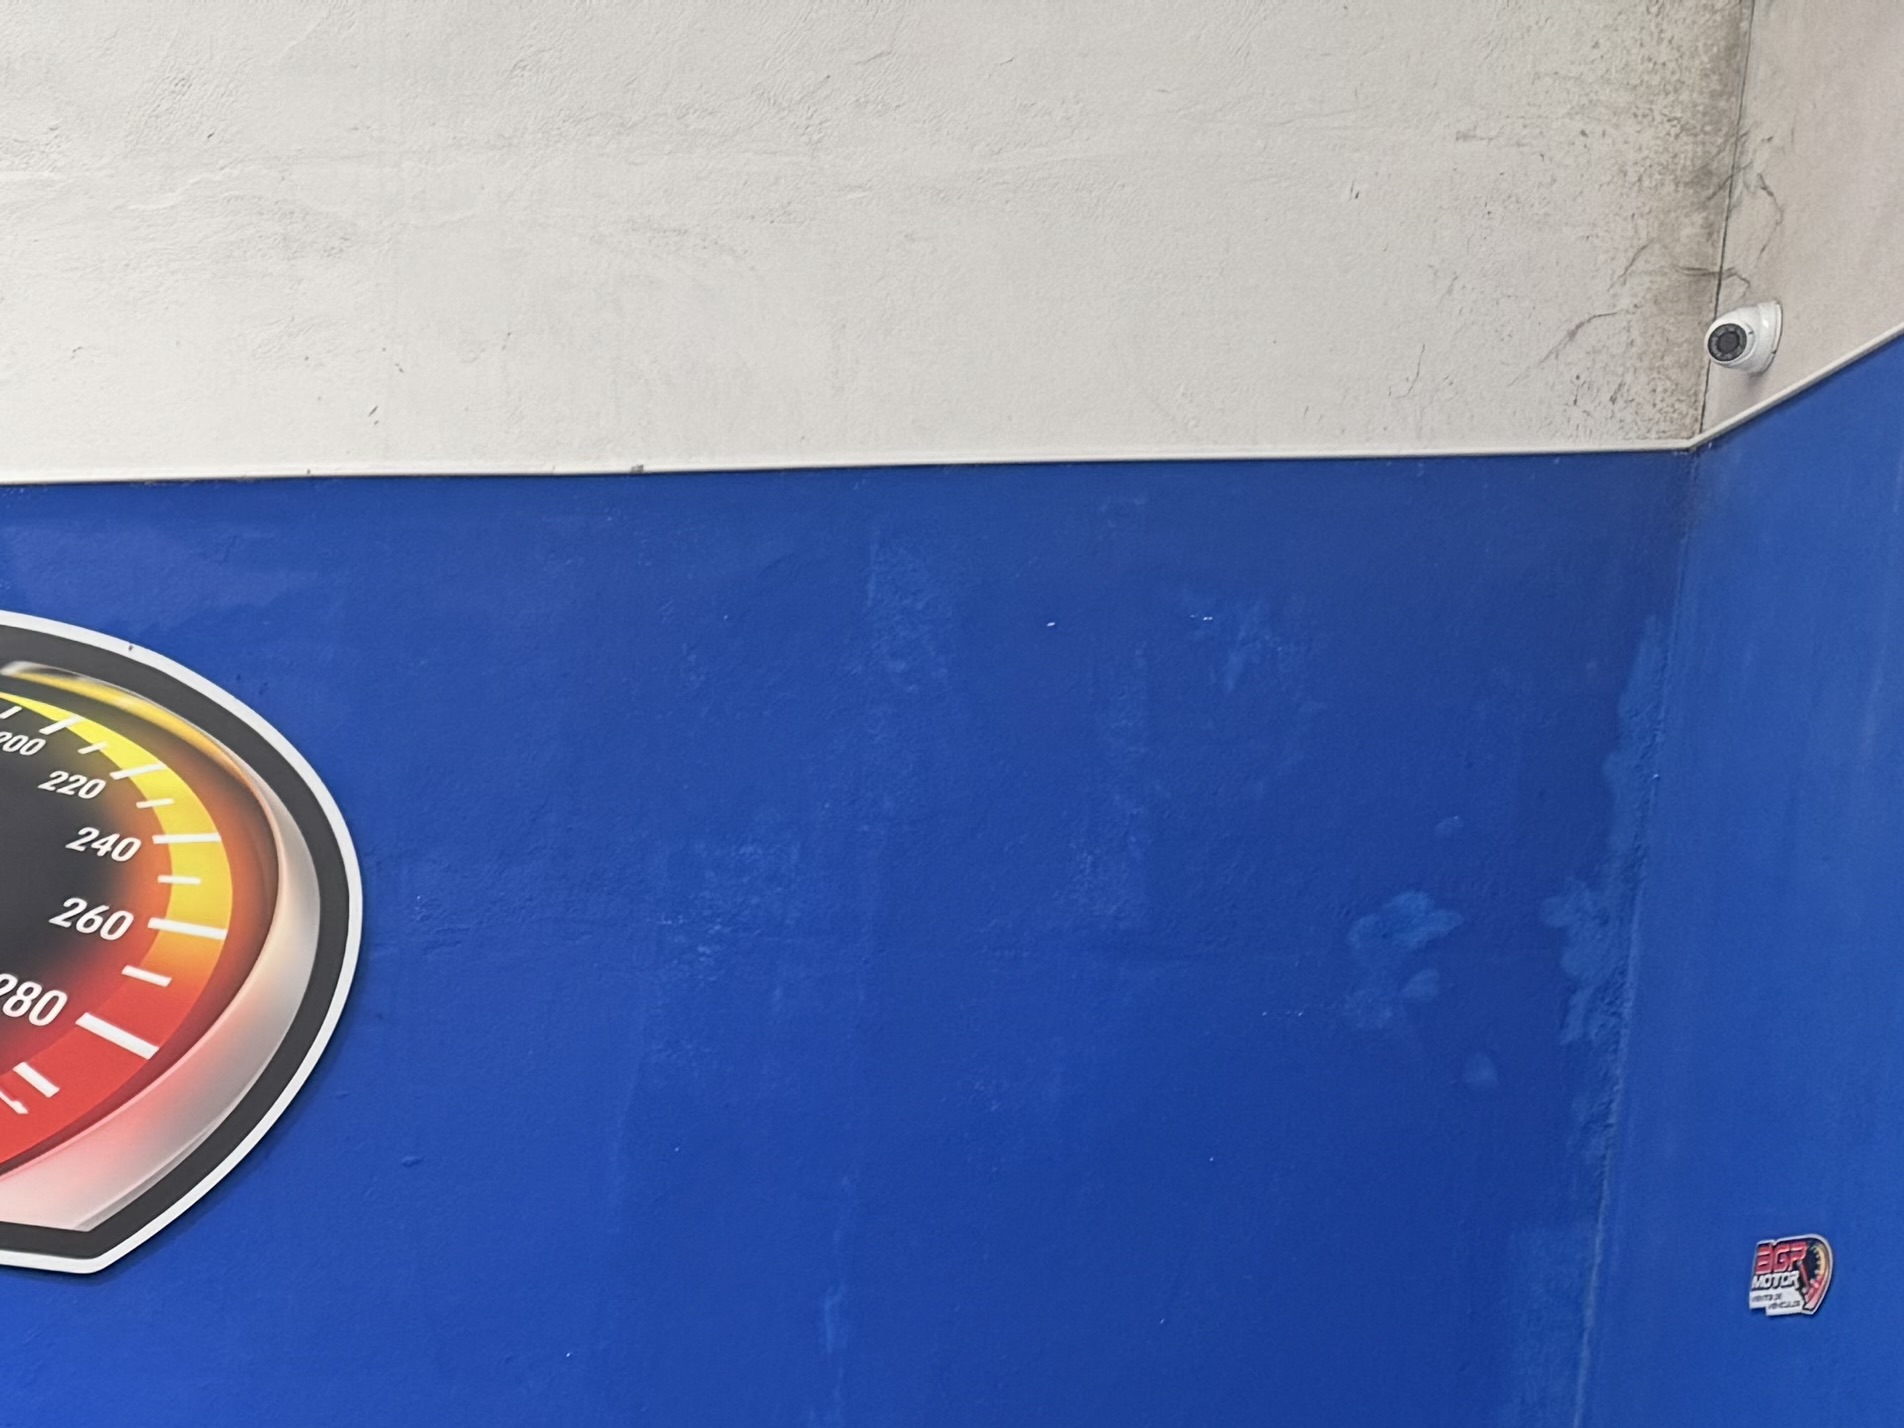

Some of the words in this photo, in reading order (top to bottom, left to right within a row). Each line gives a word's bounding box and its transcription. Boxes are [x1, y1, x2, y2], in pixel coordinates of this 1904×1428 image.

[37, 769, 107, 800] 220
[64, 826, 142, 863] 240
[48, 896, 135, 942] 260
